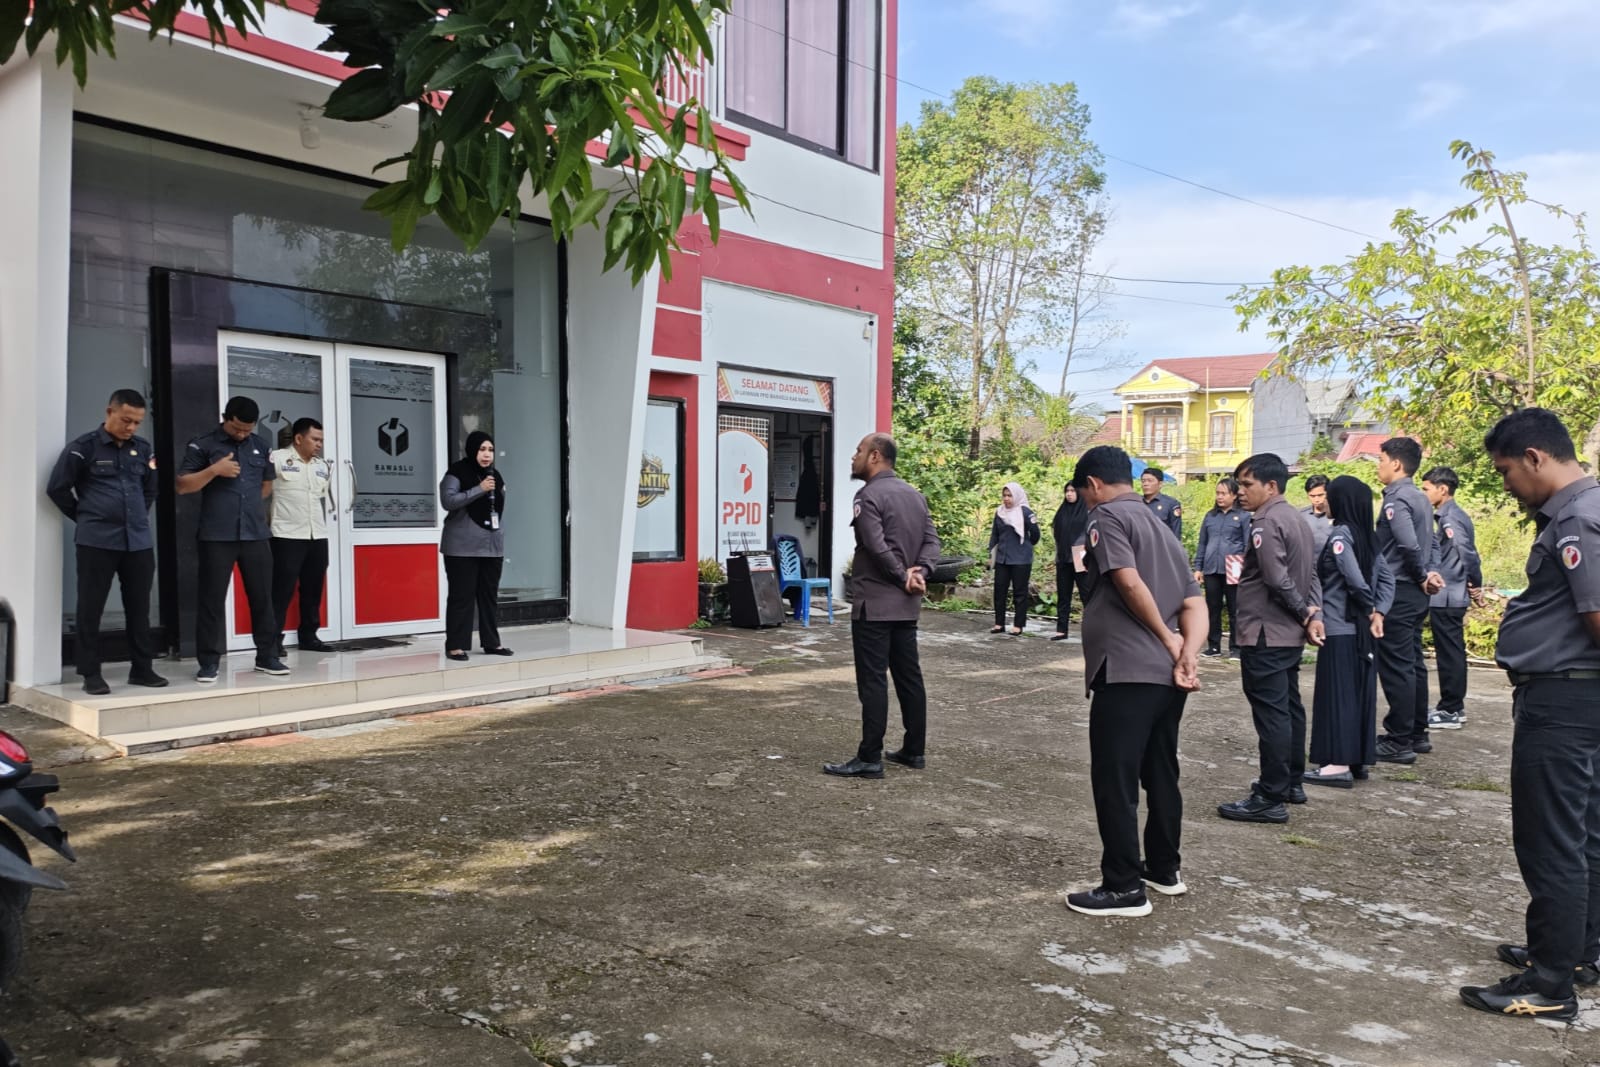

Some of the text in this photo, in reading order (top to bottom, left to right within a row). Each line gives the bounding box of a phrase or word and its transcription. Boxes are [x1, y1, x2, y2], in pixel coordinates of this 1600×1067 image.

[741, 378, 809, 395] SELAMAT DATANG
[722, 501, 762, 525] PPID
